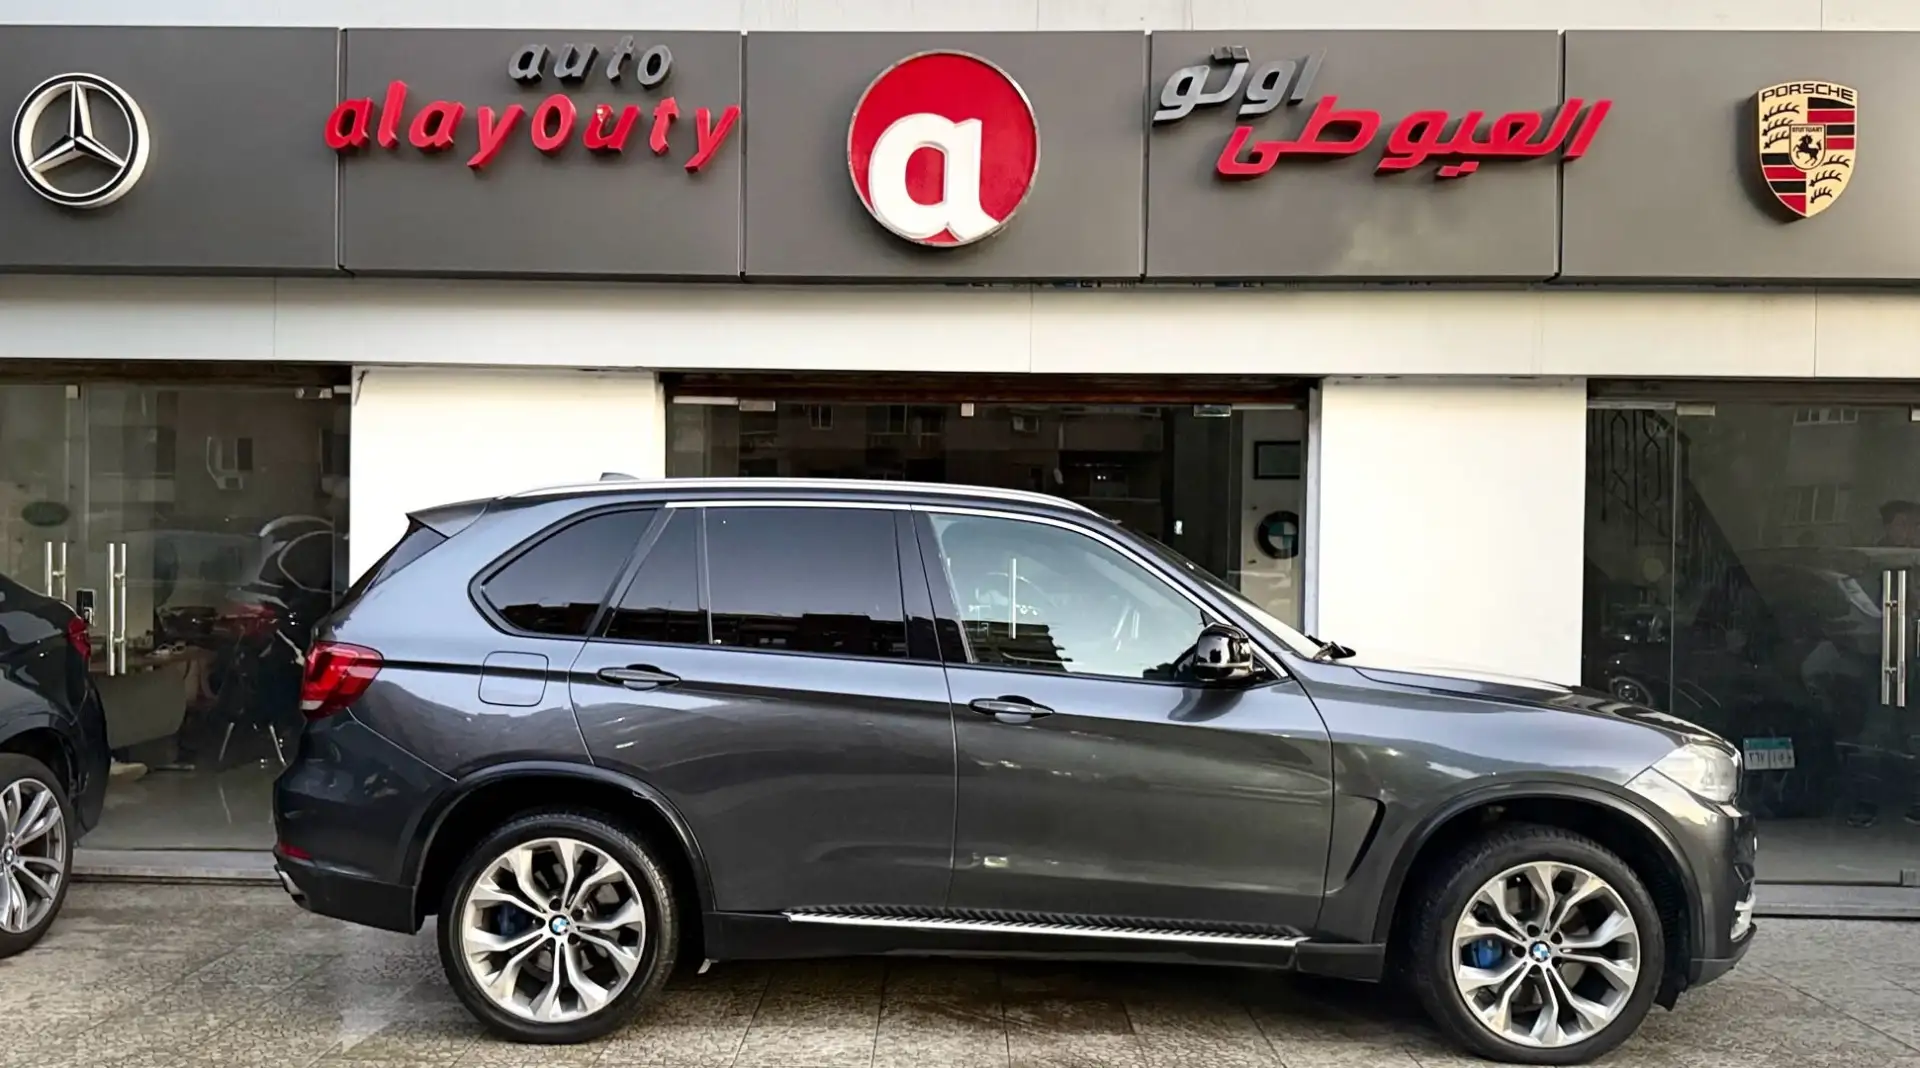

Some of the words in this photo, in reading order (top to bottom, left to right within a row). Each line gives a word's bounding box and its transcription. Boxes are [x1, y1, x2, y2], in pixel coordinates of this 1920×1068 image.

[508, 35, 675, 88] auto
[1153, 45, 1326, 121] اوتو
[1761, 83, 1854, 102] PORSCHE
[868, 112, 1000, 240] a
